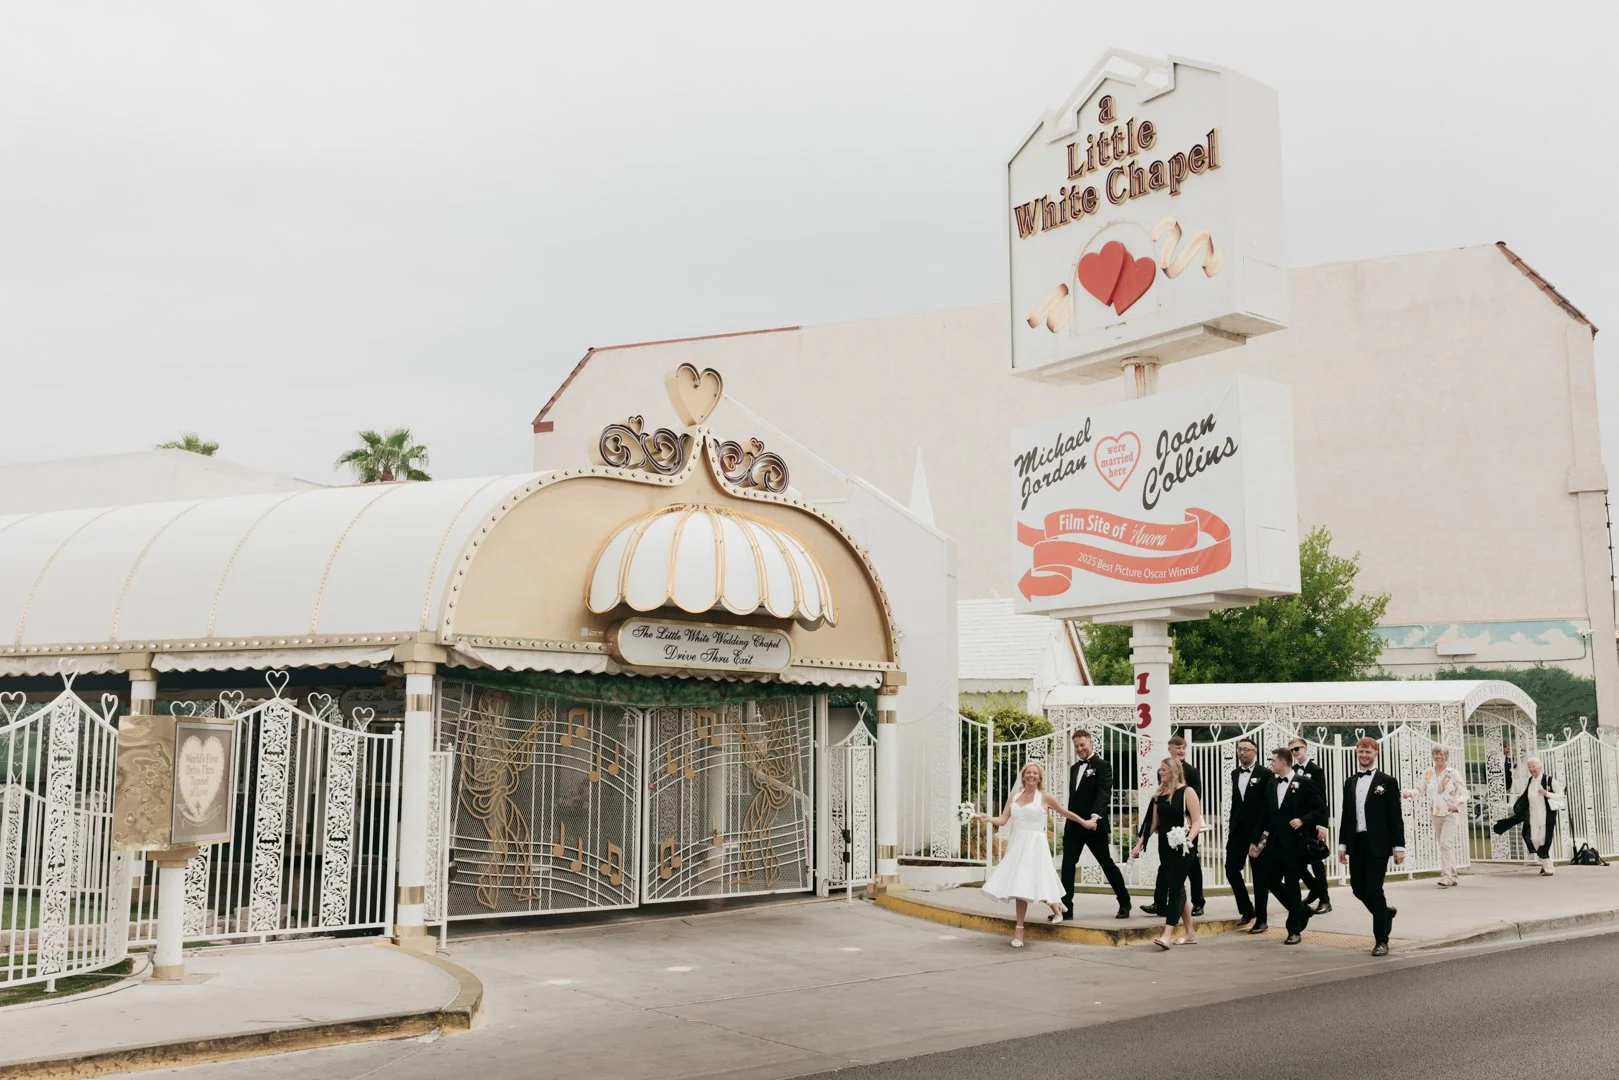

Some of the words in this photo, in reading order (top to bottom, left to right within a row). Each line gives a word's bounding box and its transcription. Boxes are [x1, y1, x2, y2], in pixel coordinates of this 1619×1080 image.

[1098, 94, 1117, 124] a
[1066, 117, 1157, 181] Little
[1013, 184, 1100, 239] White
[1105, 127, 1222, 205] Chapel
[1014, 417, 1092, 478] Michael
[1107, 442, 1126, 455] were
[1155, 412, 1217, 475] Joan
[1101, 451, 1135, 468] married
[1108, 466, 1127, 478] here
[1021, 455, 1087, 511] Jordan
[1142, 436, 1239, 511] Collins
[1059, 513, 1084, 531] Film
[1087, 515, 1110, 535] Site
[1112, 523, 1128, 539] of
[1078, 552, 1097, 566] 2025
[1097, 559, 1113, 573] Best
[1115, 565, 1142, 578] Picture
[1143, 568, 1167, 579] Oscar
[1168, 564, 1200, 578] Winner
[632, 625, 653, 639] The
[656, 627, 682, 641] Little
[684, 628, 710, 643] White
[712, 631, 750, 650] Wedding
[752, 635, 782, 651] Chapel
[663, 644, 697, 661] Drive
[700, 648, 729, 663] Thru
[732, 650, 754, 665] Exit
[186, 765, 200, 775] Drive
